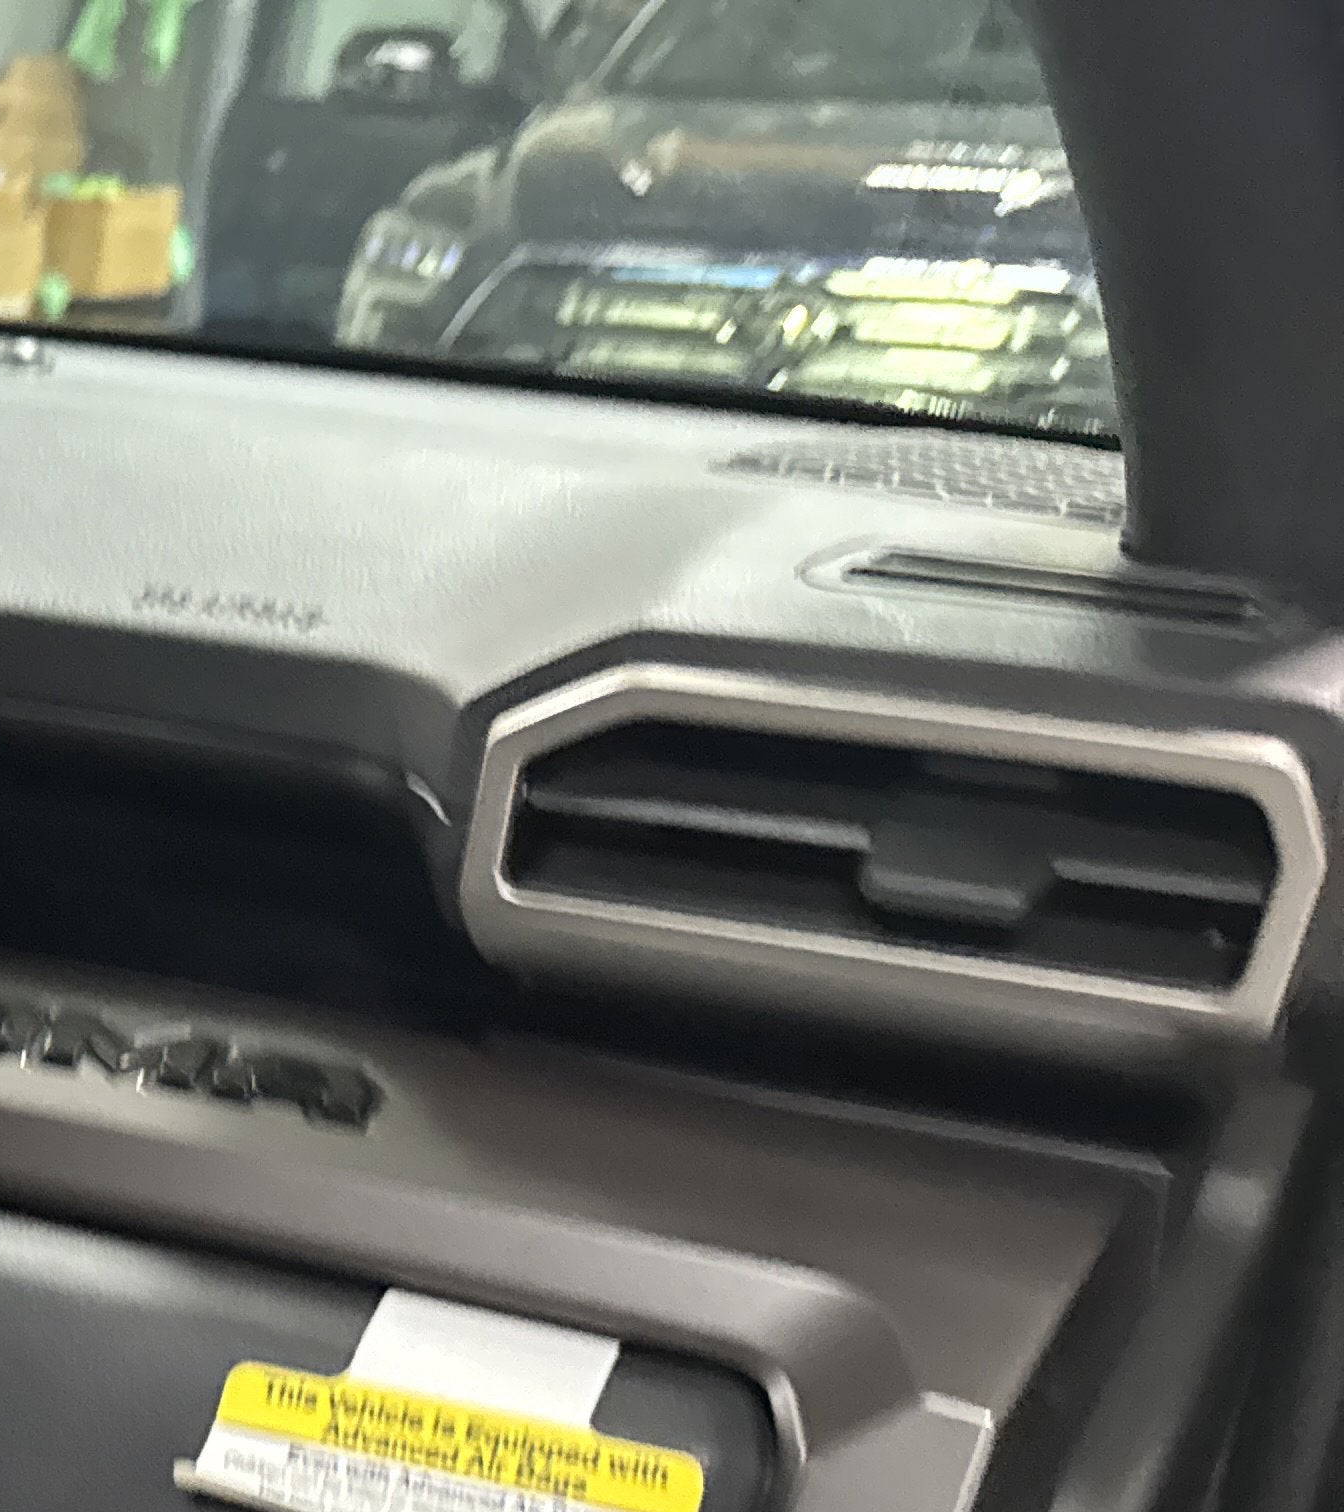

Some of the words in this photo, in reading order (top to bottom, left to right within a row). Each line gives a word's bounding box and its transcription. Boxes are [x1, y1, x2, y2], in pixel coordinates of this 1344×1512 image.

[263, 1375, 318, 1413] This
[328, 1385, 425, 1434] Vehicle
[464, 1414, 602, 1477] Equipped
[608, 1450, 670, 1492] with
[320, 1420, 459, 1472] Advanced
[461, 1441, 503, 1485] Air
[514, 1452, 588, 1501] Bags
